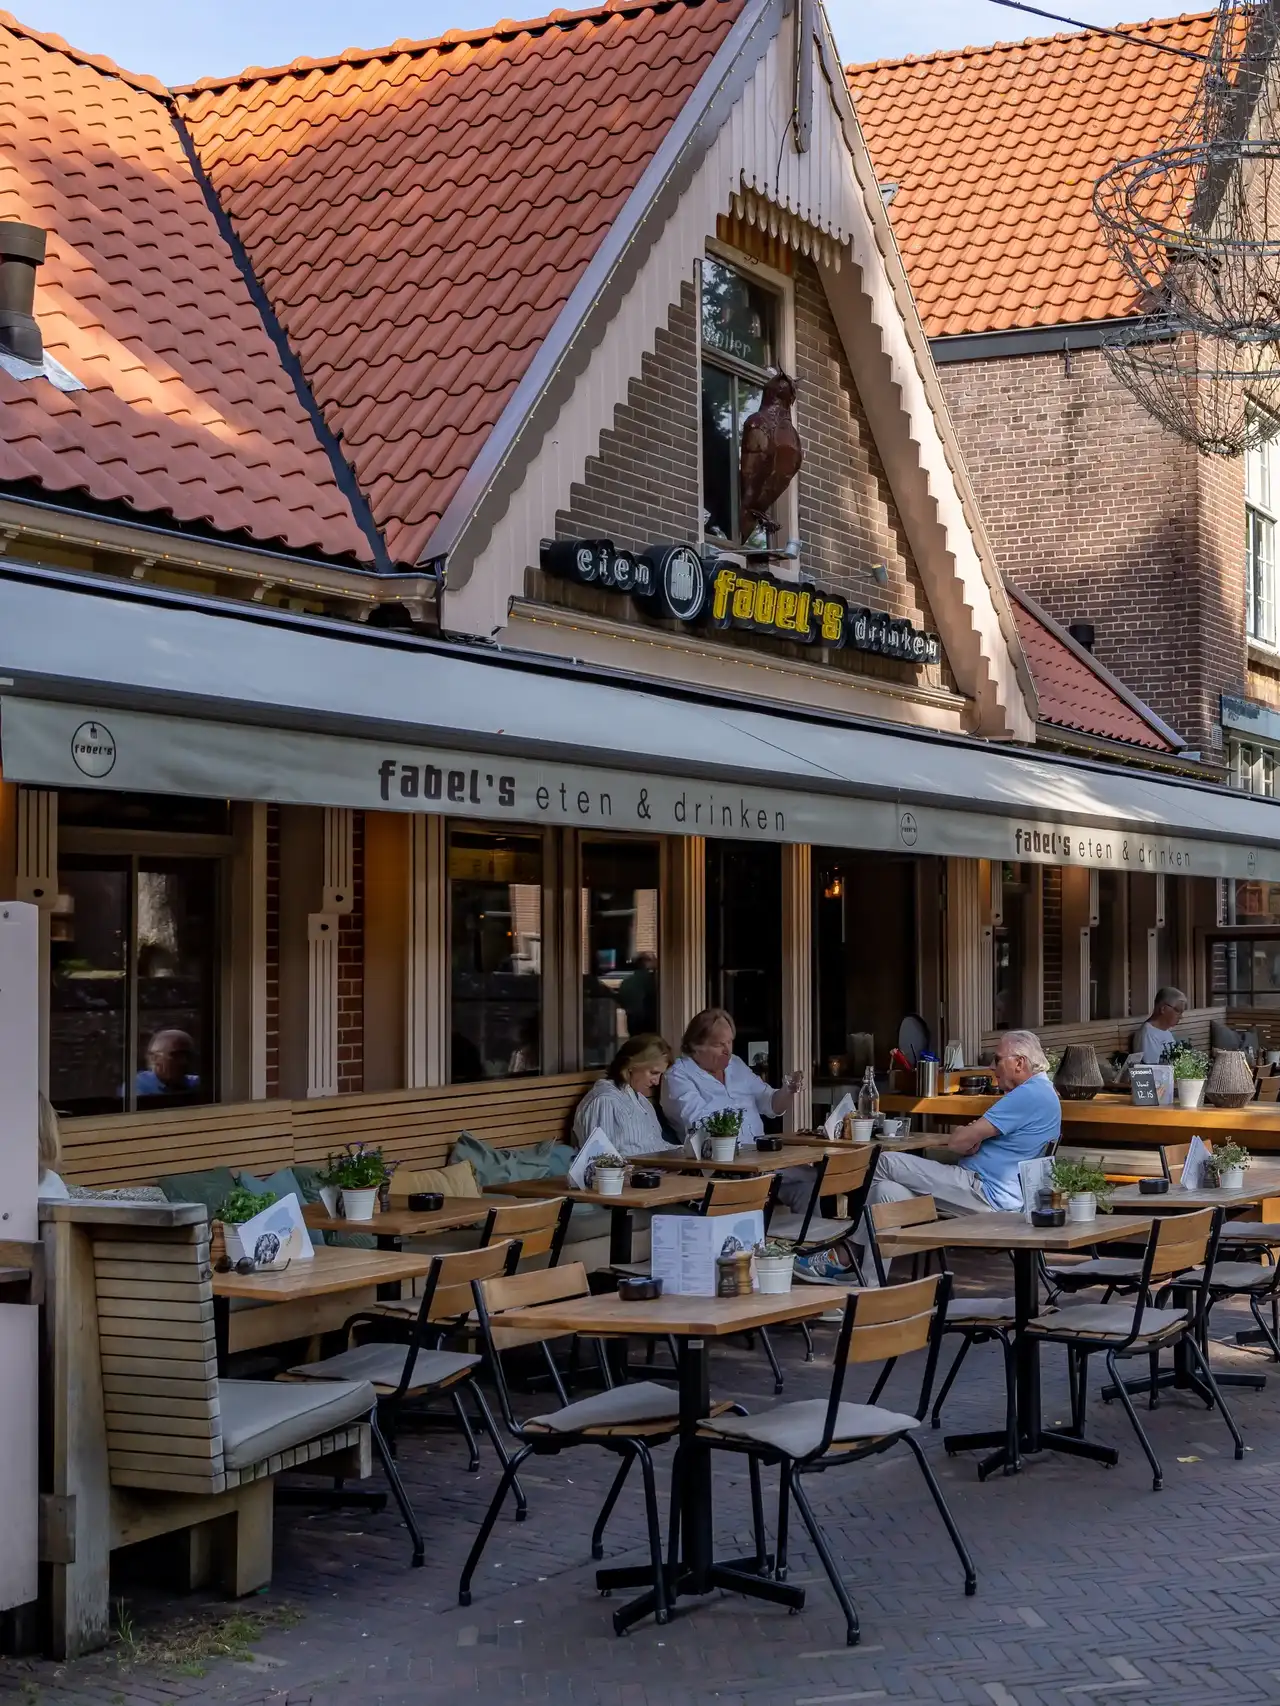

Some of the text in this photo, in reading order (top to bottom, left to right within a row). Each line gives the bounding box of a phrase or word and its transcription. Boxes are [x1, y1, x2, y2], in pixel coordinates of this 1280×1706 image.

[577, 548, 938, 656] eten fabel's drinken
[75, 744, 113, 756] fabel's
[378, 759, 785, 831] fabel's eten & drinken
[1015, 828, 1191, 866] fabel's eten & drinken
